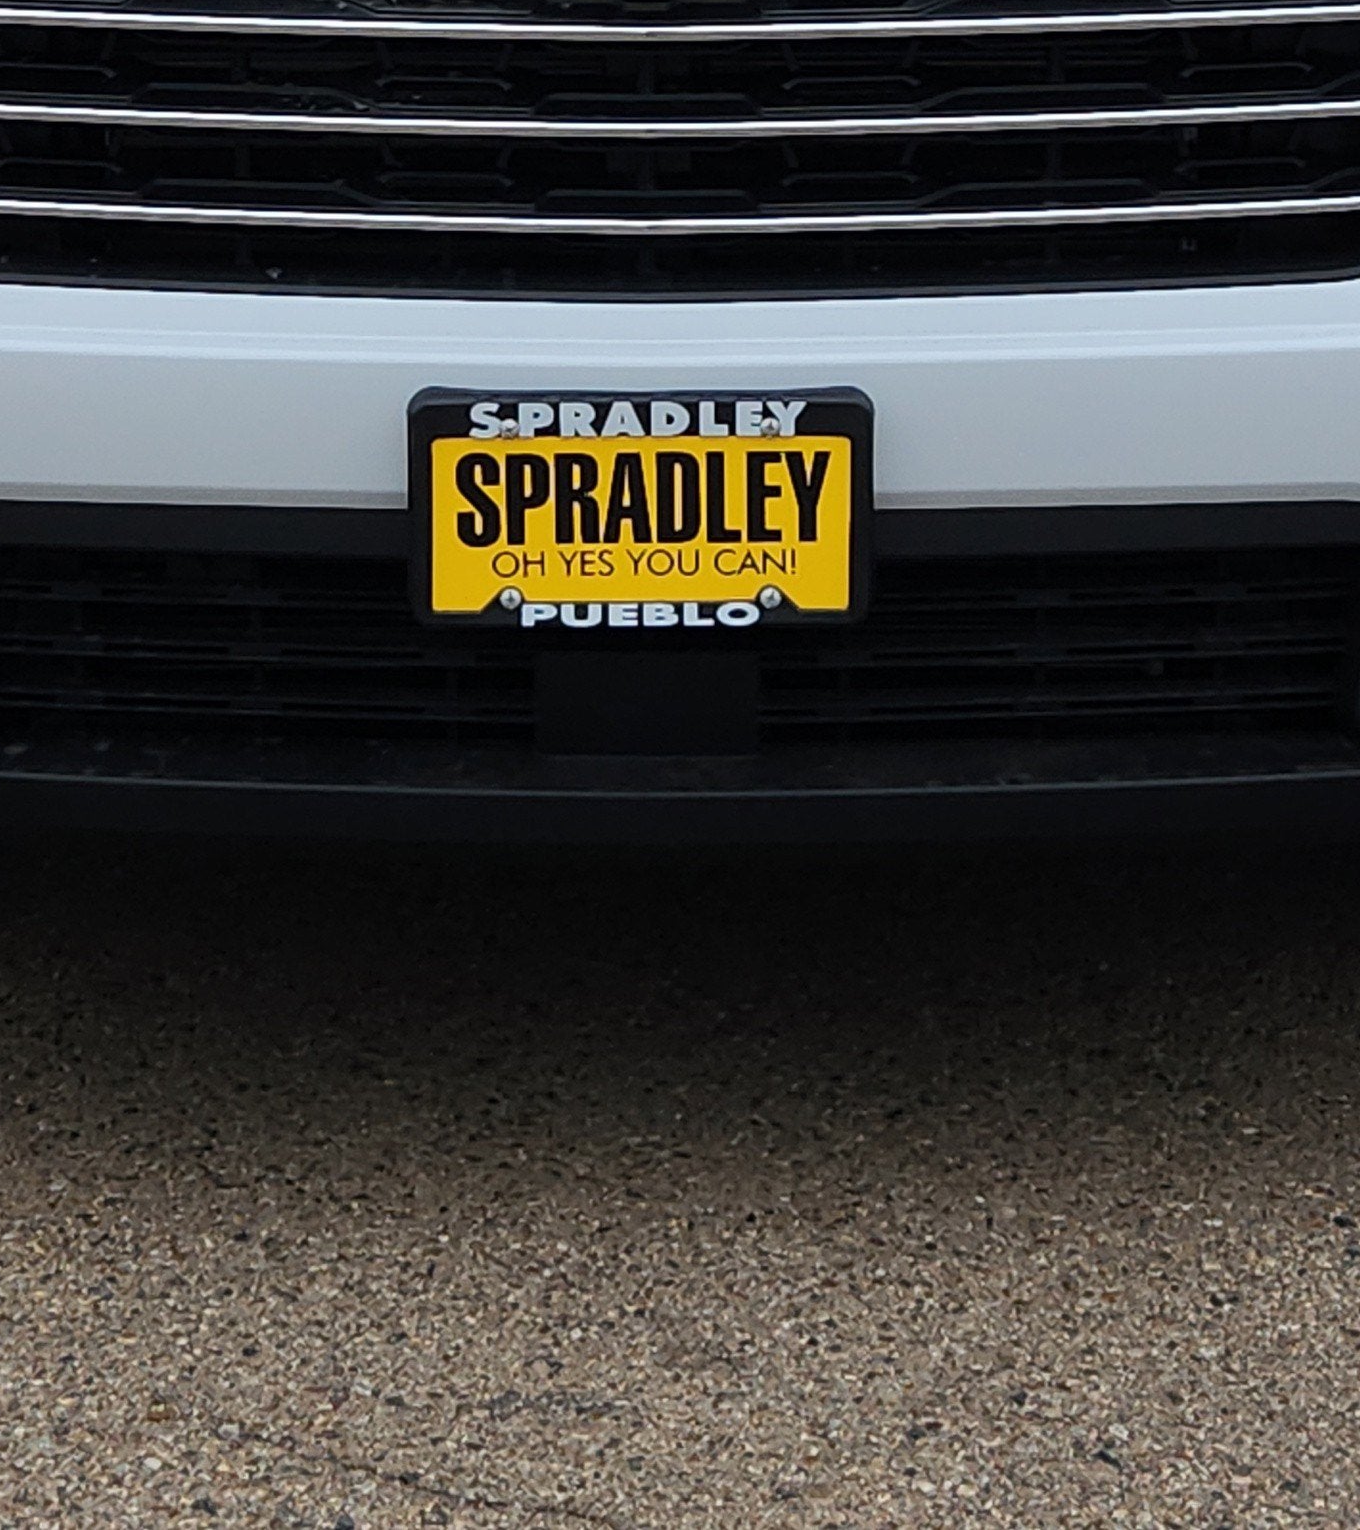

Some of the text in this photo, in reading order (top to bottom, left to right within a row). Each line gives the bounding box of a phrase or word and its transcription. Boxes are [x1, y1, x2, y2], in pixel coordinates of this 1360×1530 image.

[469, 400, 807, 438] SPRADLEY
[455, 450, 831, 547] SPRADLEY
[491, 547, 797, 578] OH YES YOU CAN!
[520, 602, 760, 628] PUEBLO
